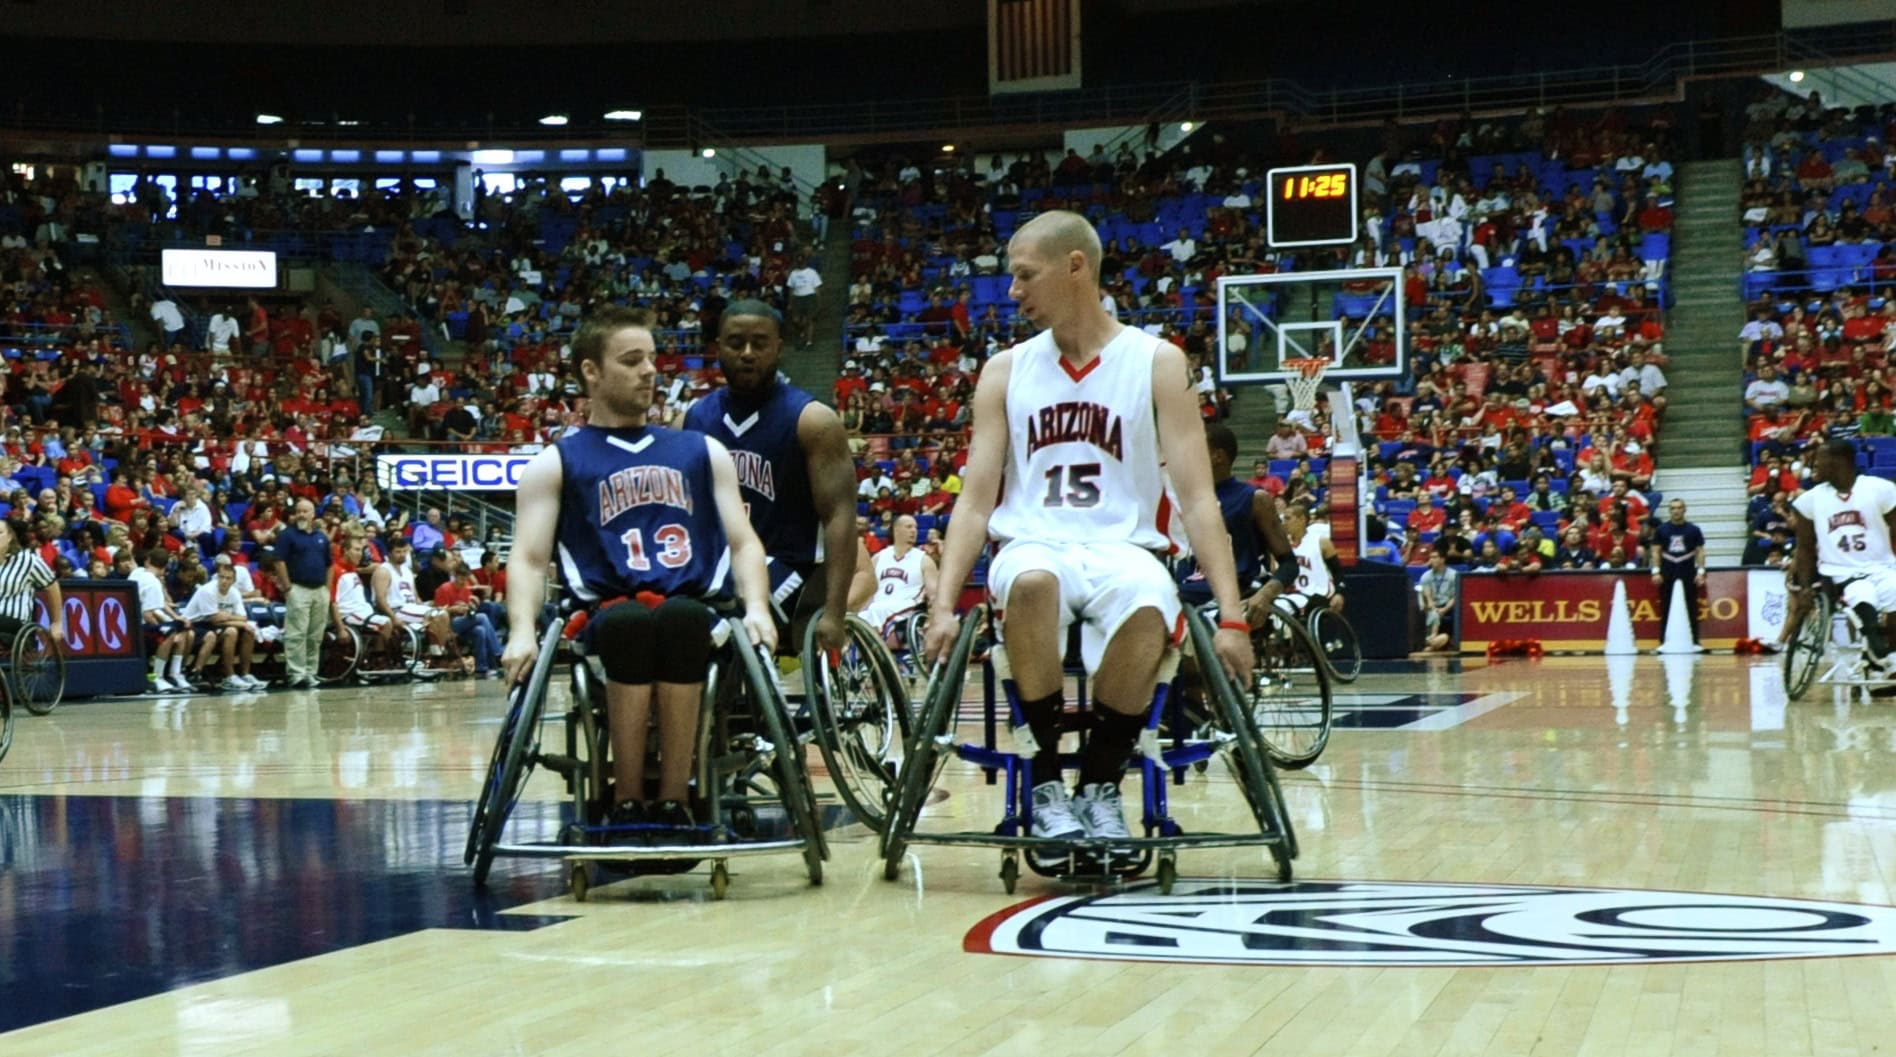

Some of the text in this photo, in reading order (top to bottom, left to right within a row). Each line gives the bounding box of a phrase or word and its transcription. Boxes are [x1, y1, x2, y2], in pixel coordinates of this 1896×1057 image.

[1284, 174, 1347, 199] 11:25
[1026, 401, 1123, 463] ARIZONA
[1043, 462, 1101, 508] 15
[621, 523, 692, 571] 13
[1837, 532, 1867, 552] 45
[885, 583, 895, 595] 0
[1470, 599, 1602, 623] WELLS
